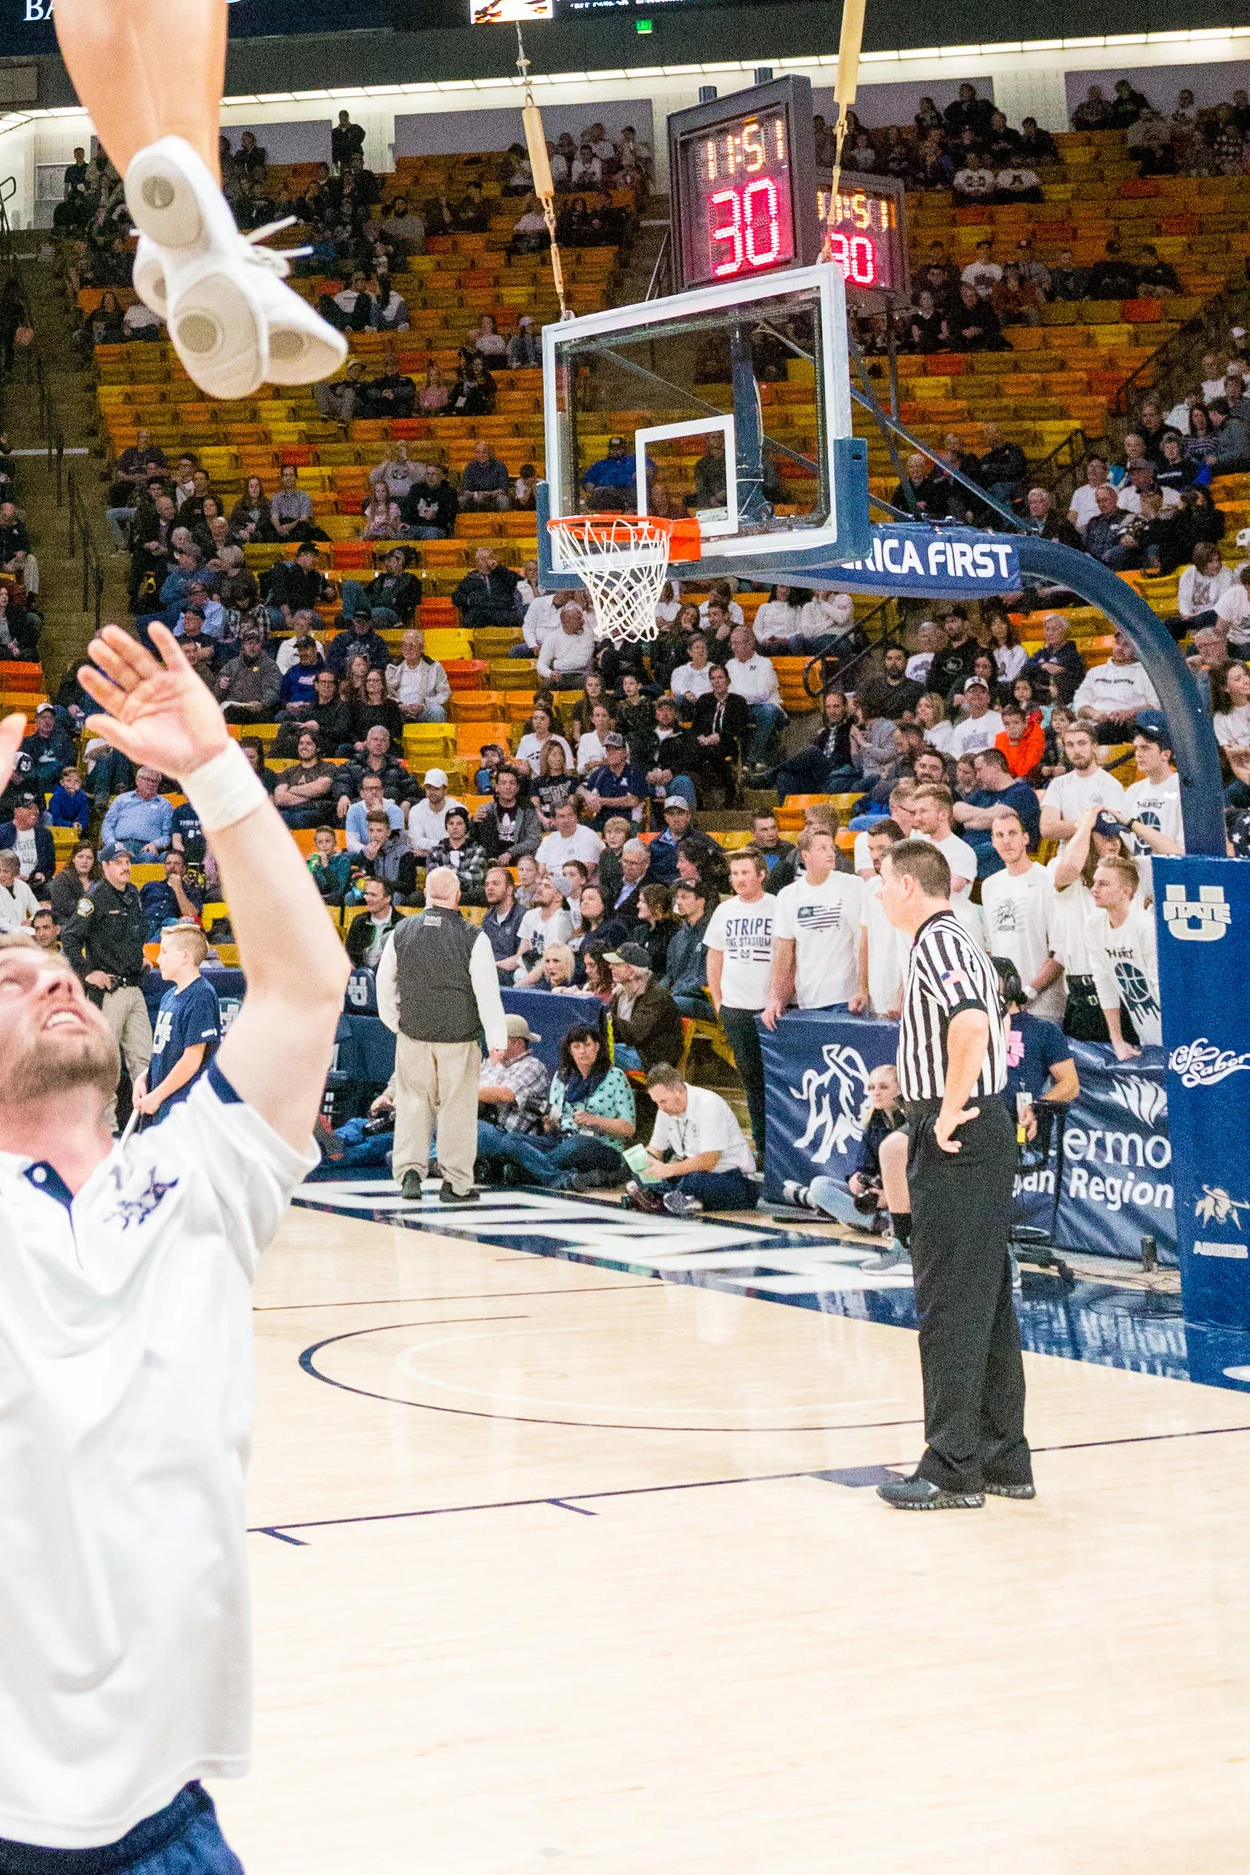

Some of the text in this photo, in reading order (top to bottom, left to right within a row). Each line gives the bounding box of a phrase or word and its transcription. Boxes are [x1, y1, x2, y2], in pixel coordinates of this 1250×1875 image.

[706, 118, 785, 182] 11:51
[711, 176, 781, 277] 30
[927, 541, 1013, 579] FIRST
[725, 918, 773, 937] STRIPE
[1162, 901, 1232, 924] STATE
[739, 936, 772, 948] STADIUM
[1063, 1127, 1172, 1170] ermo
[1069, 1167, 1175, 1212] Region
